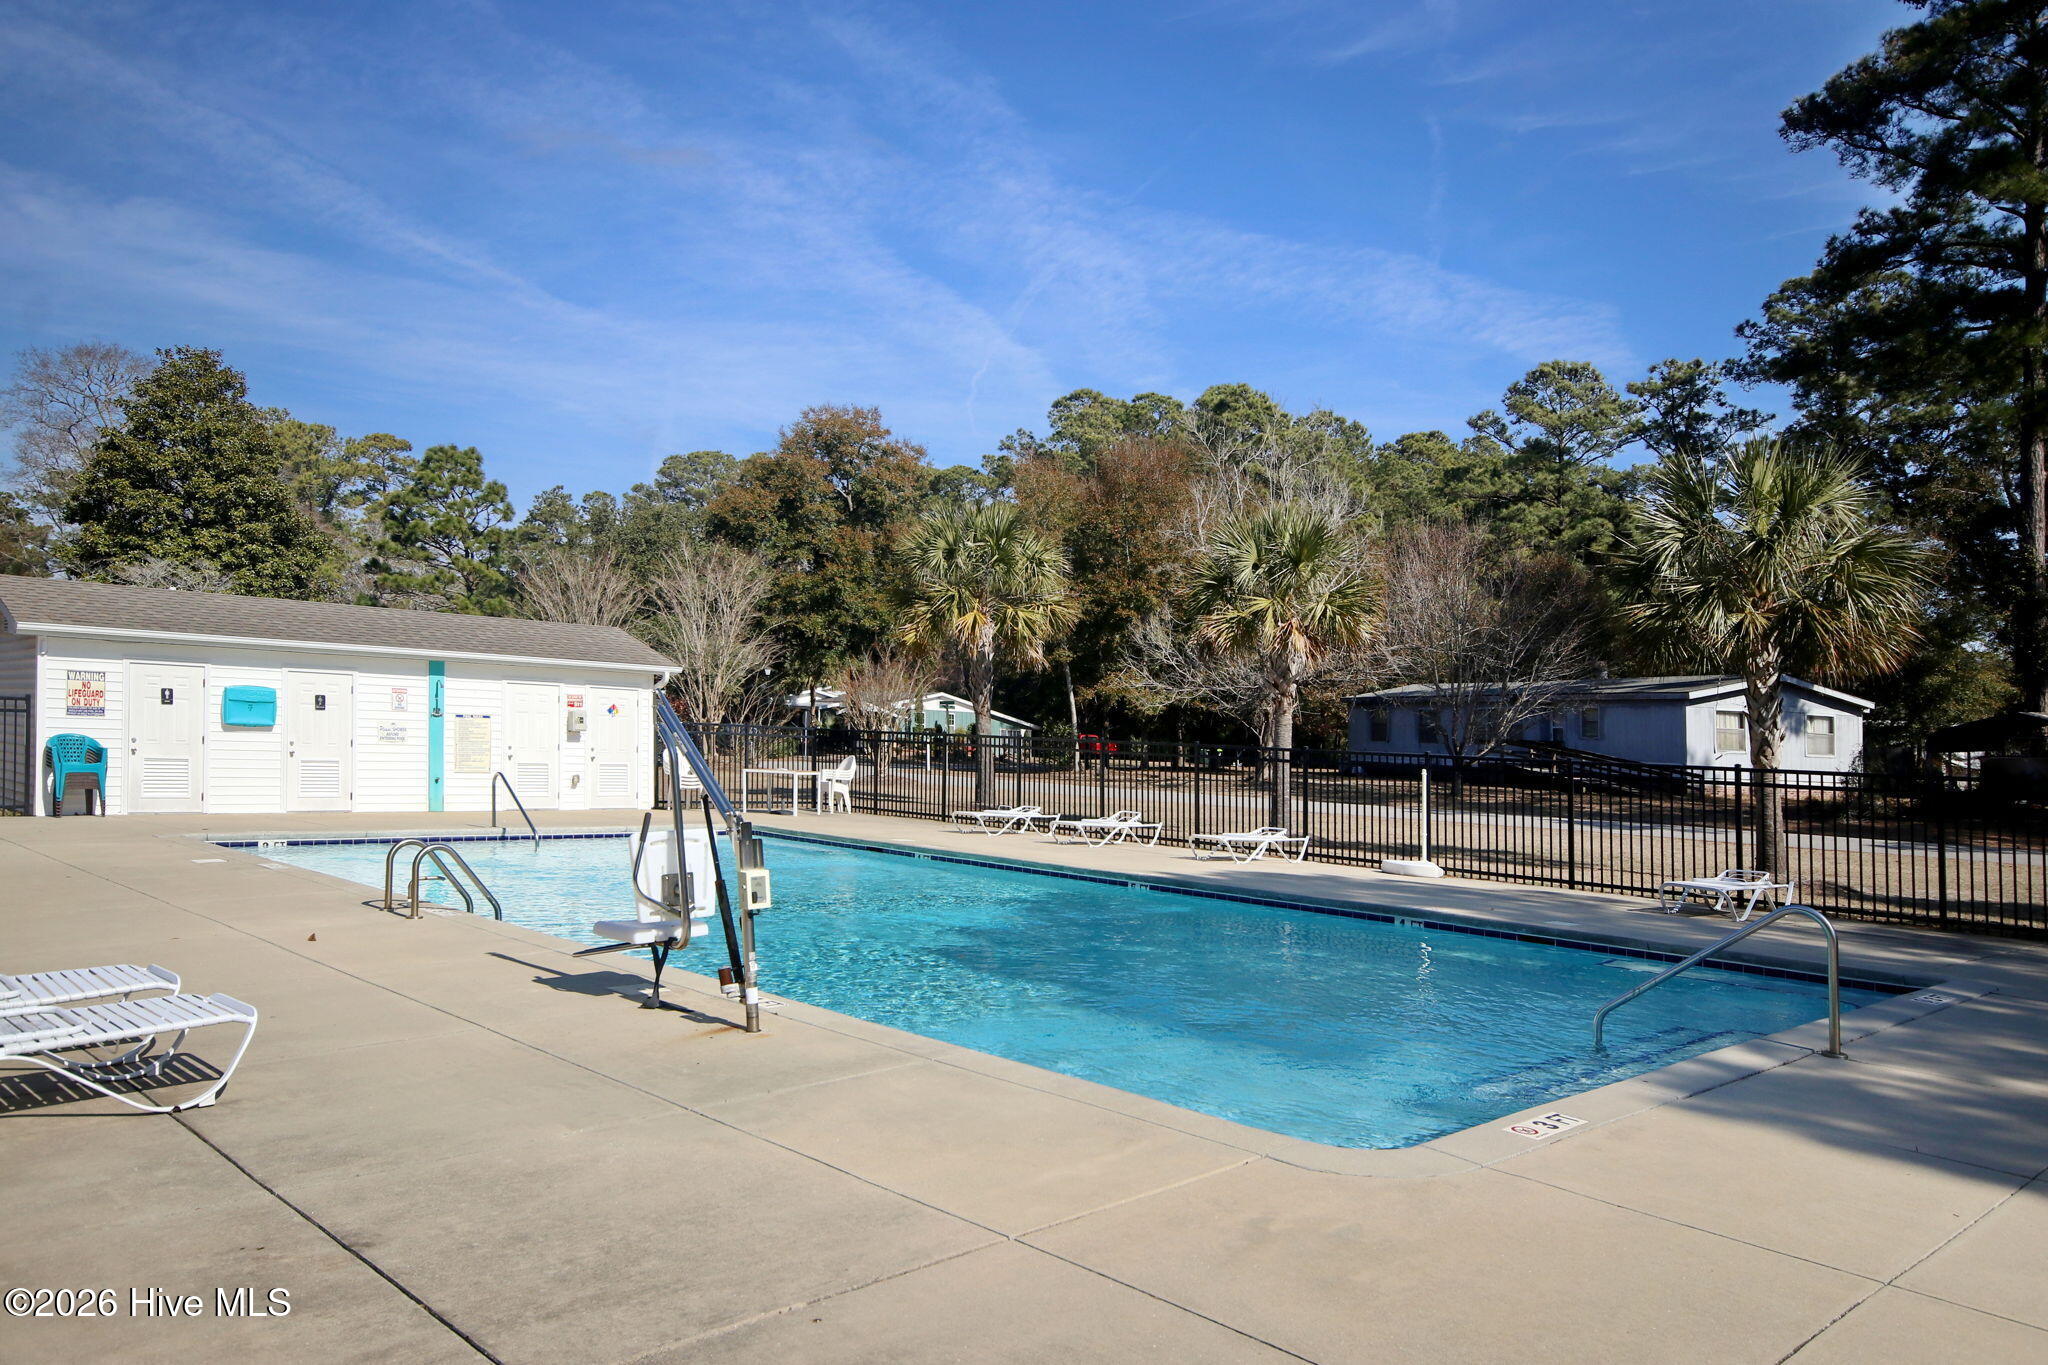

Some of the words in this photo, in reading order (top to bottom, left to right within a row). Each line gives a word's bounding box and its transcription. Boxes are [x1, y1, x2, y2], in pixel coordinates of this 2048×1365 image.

[68, 671, 105, 681] WARNING
[82, 681, 91, 690] NO
[68, 689, 104, 698] LIFEGUARD
[71, 698, 81, 706] ON
[84, 698, 100, 707] DUTY
[1545, 1113, 1580, 1126] FT
[1532, 1120, 1560, 1130] 3
